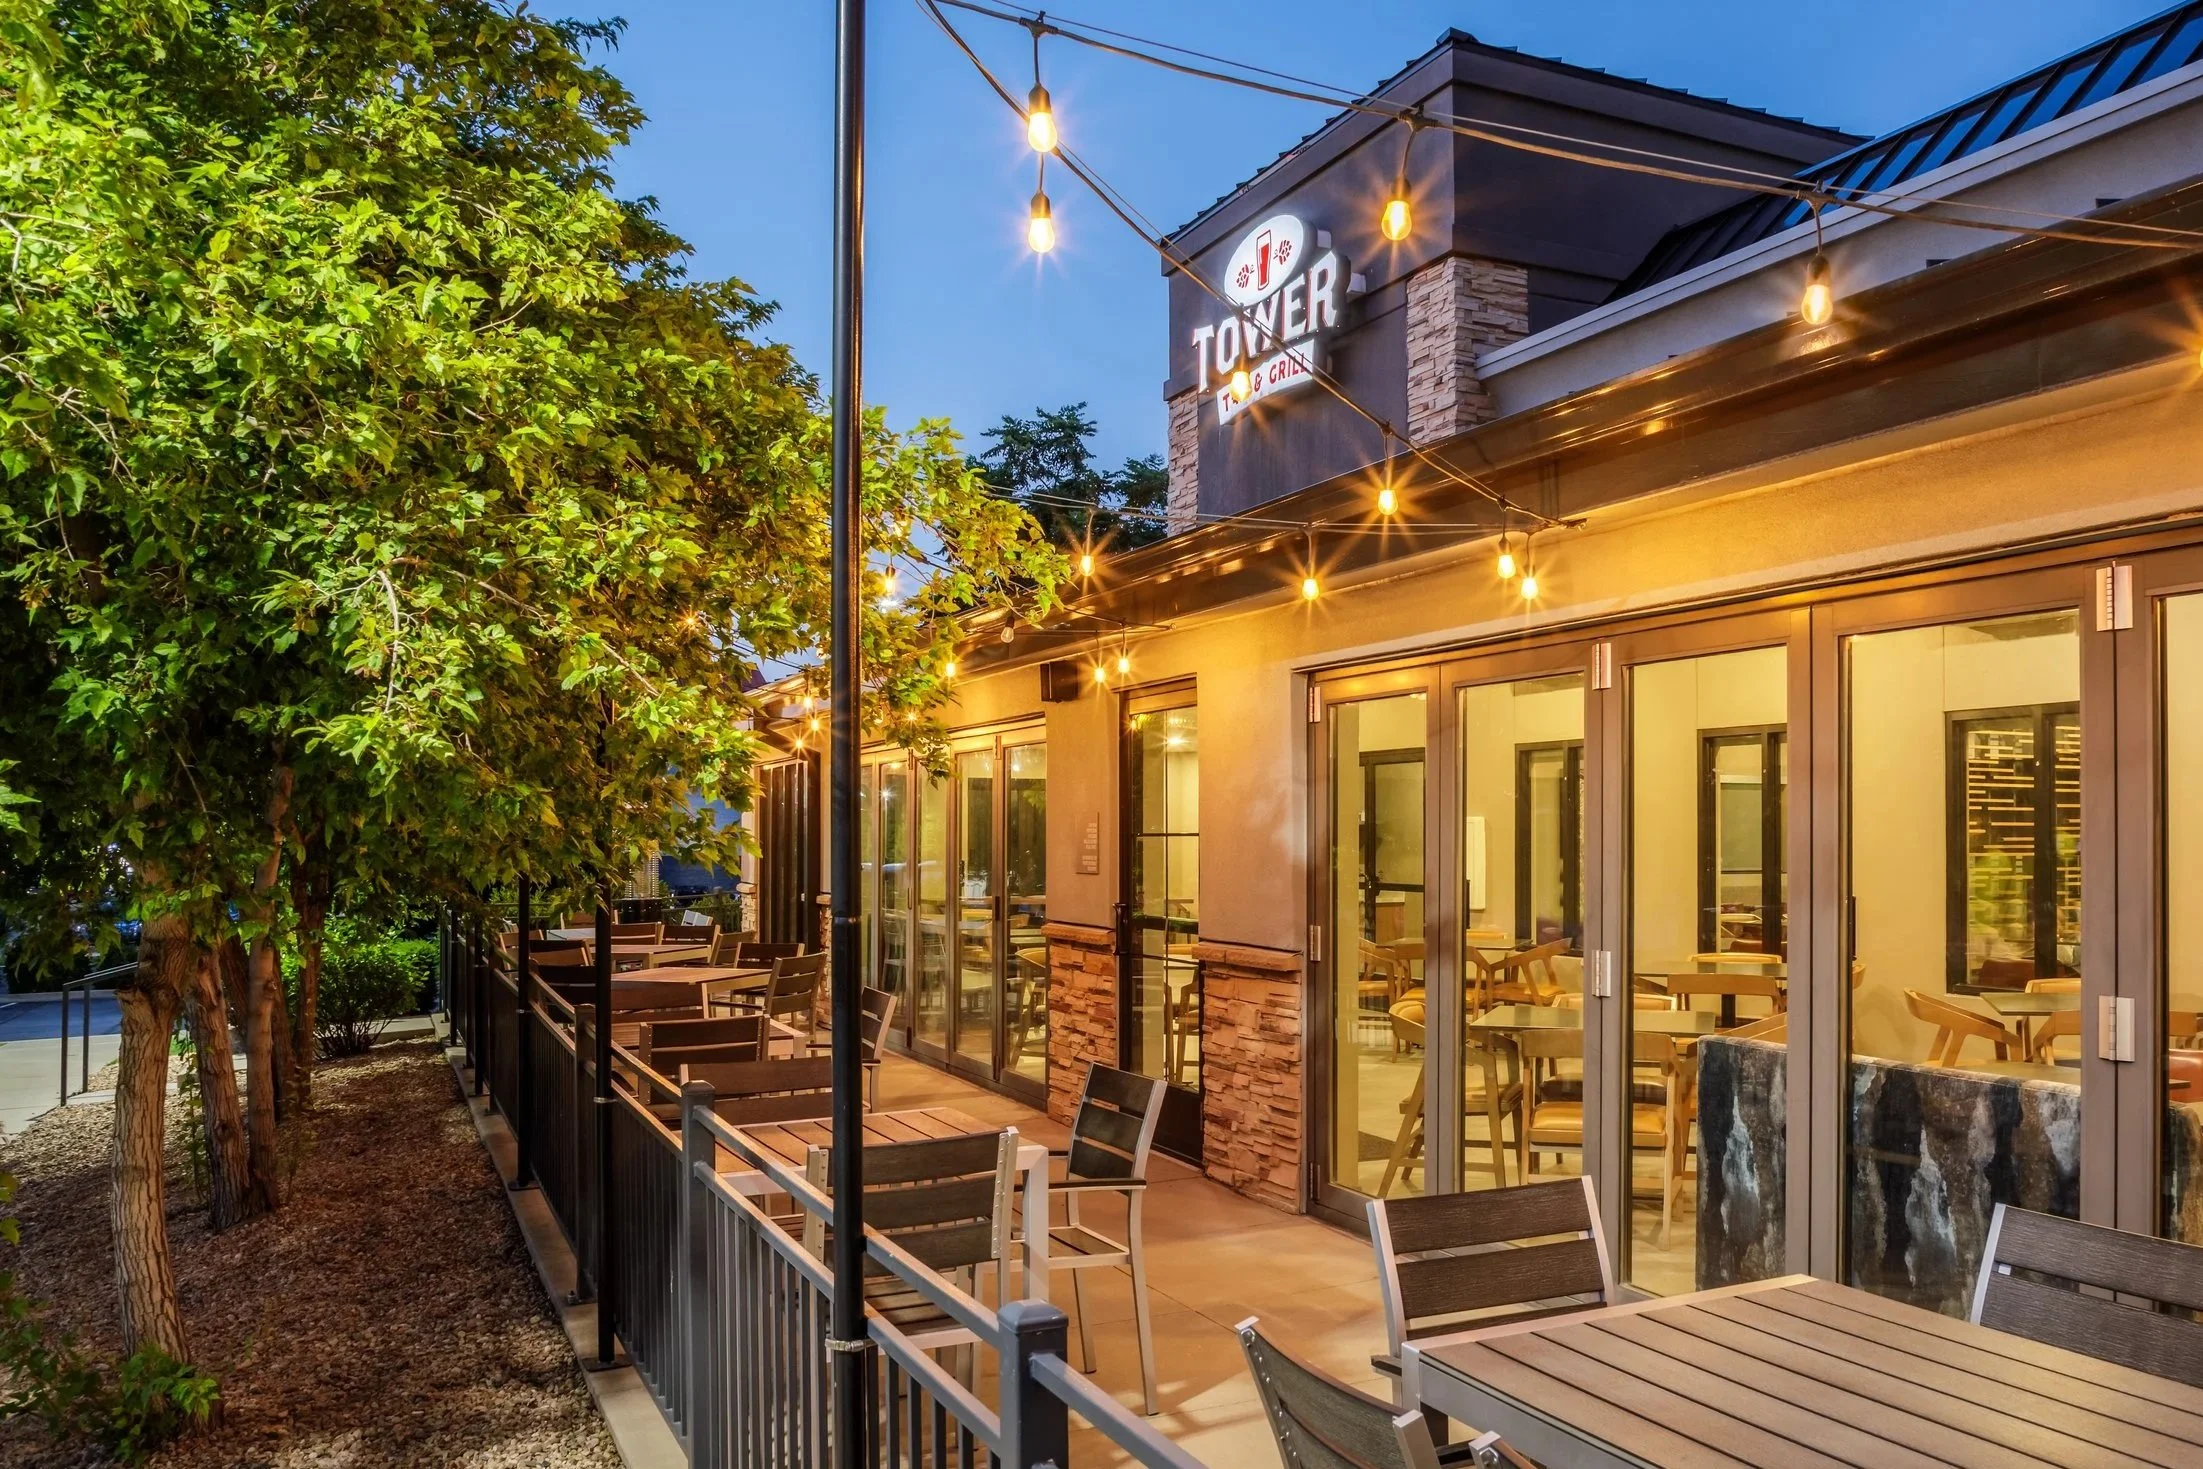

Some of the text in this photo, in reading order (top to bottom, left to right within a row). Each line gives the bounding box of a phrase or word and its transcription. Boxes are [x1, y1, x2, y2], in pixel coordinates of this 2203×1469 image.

[1192, 251, 1338, 393] TOWER
[1254, 353, 1307, 393] & GRILL
